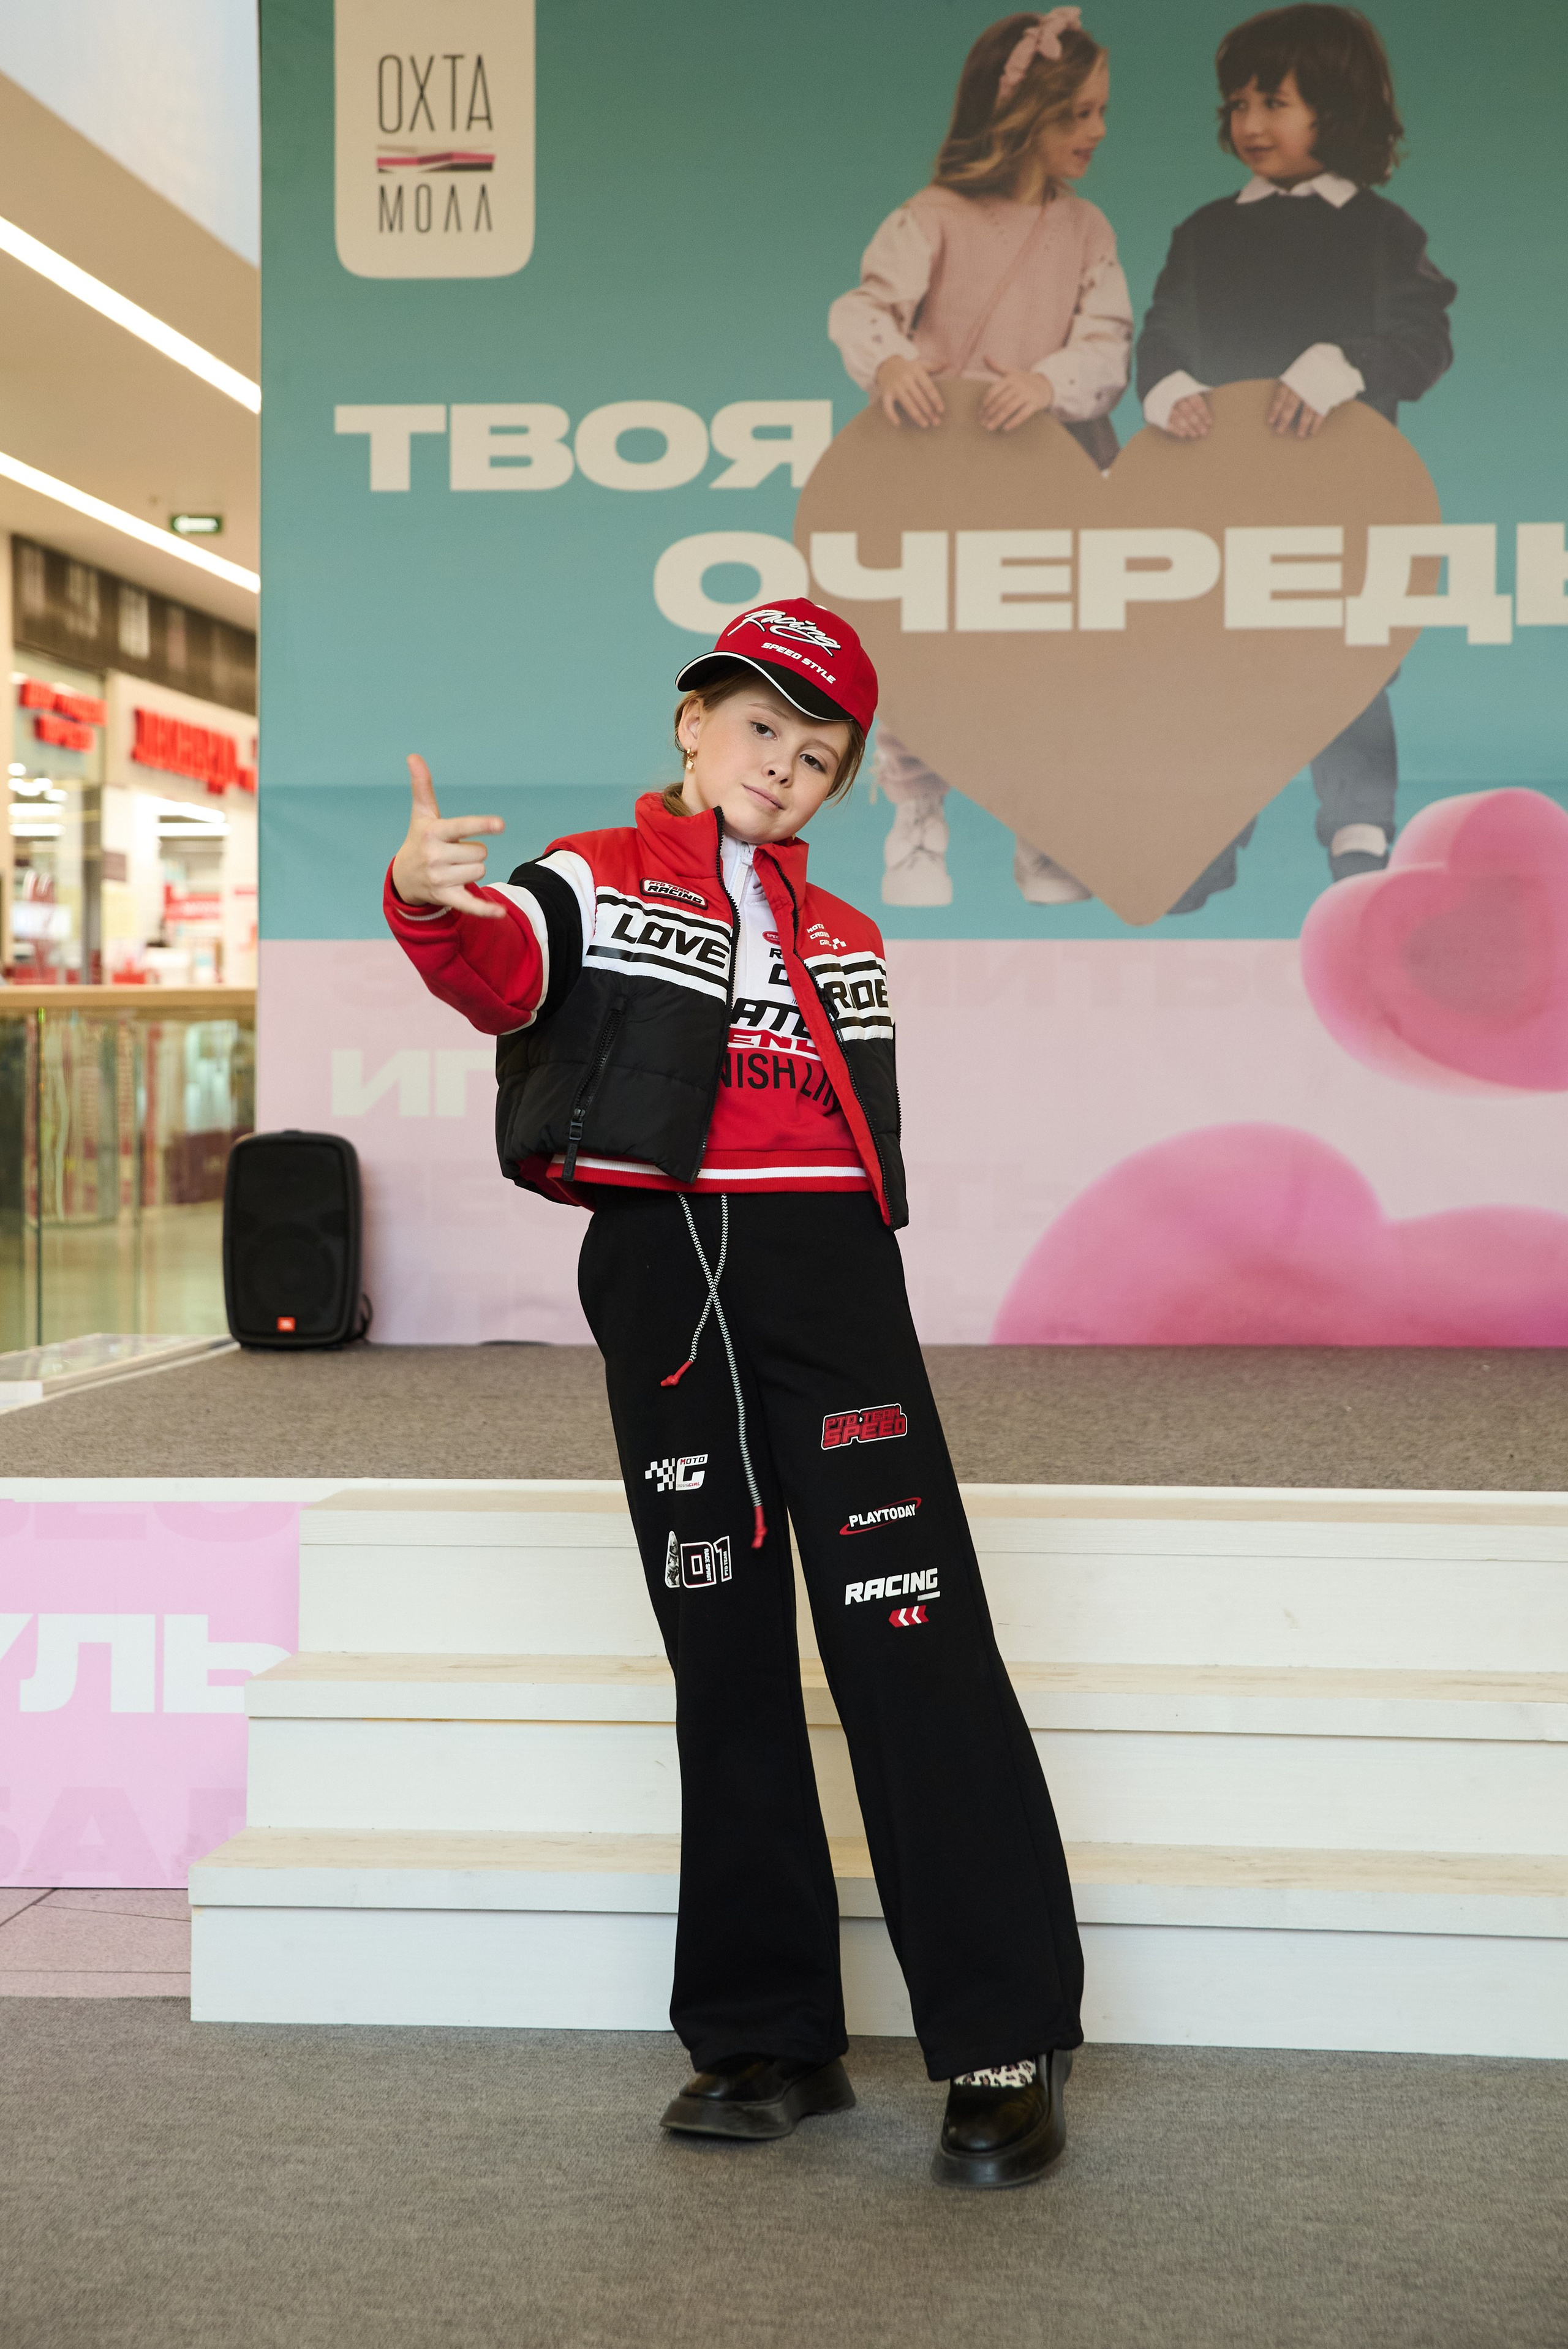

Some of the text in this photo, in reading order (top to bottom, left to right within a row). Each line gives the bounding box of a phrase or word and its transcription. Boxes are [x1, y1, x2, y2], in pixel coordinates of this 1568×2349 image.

[377, 54, 494, 134] ОХТА
[379, 183, 493, 233] МОЛЛ
[334, 400, 832, 491] ТВОЯ
[761, 642, 837, 684] SPEED STYLE
[647, 885, 703, 903] RACING
[668, 884, 691, 894] TEAM
[611, 913, 730, 969] LOVE
[823, 1416, 907, 1448] SPEED
[825, 1406, 900, 1430] PTD TEAM
[680, 1457, 705, 1465] MOTO
[849, 1504, 916, 1528] PLAYTODAY
[845, 1567, 938, 1605] RACING
[0, 1613, 292, 1713] ЛЬ
